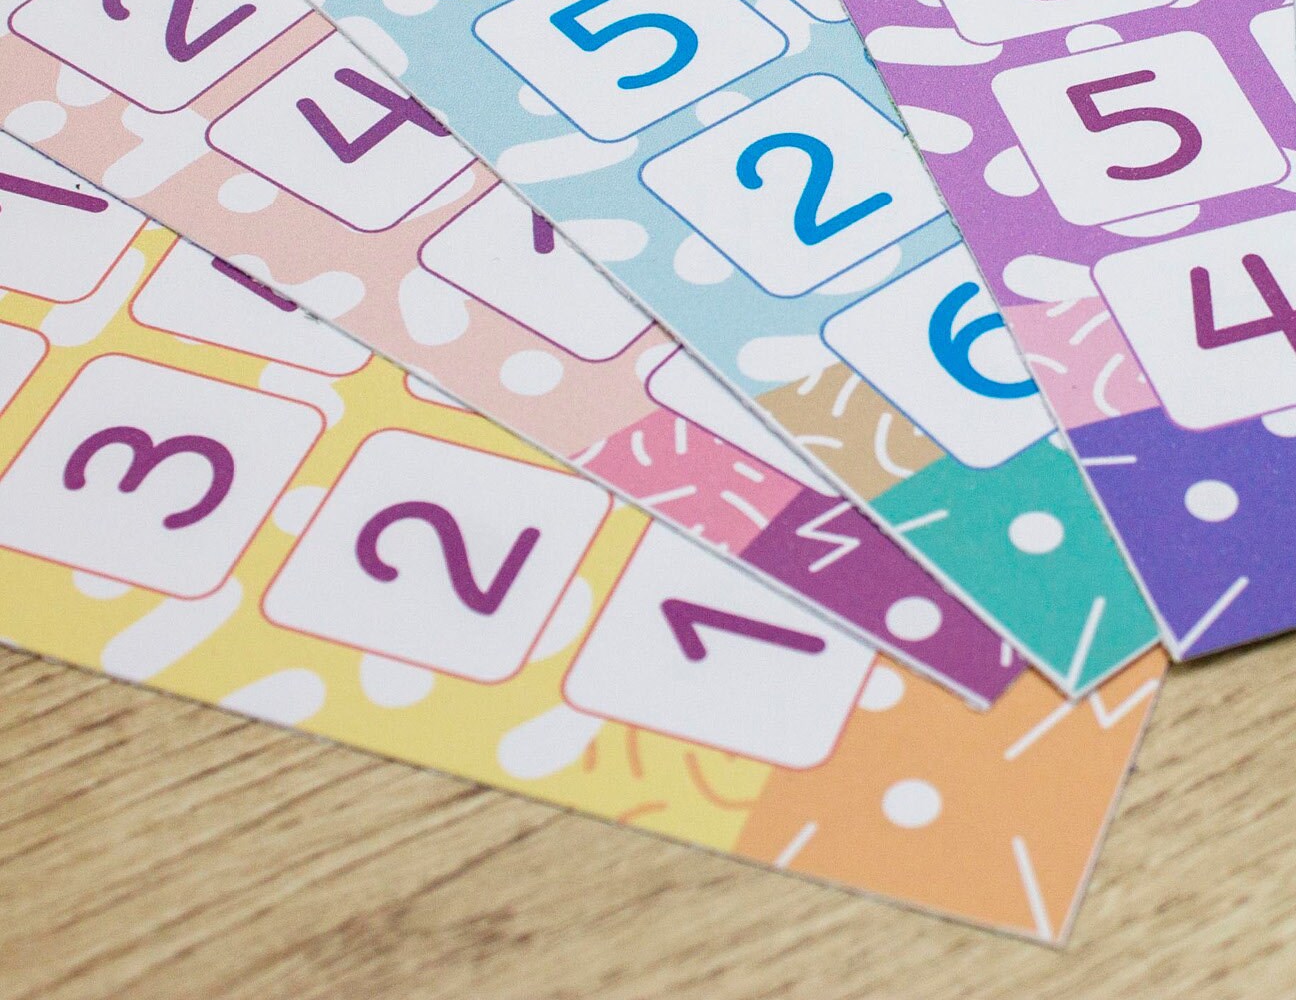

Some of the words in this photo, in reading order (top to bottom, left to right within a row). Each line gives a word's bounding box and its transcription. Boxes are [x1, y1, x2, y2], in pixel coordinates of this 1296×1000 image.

[296, 67, 450, 164] 4
[1066, 70, 1203, 181] 5
[735, 131, 895, 247] 2
[928, 281, 1041, 400] 6
[63, 425, 236, 530] 3
[355, 500, 542, 616] 2
[661, 598, 827, 663] 1
